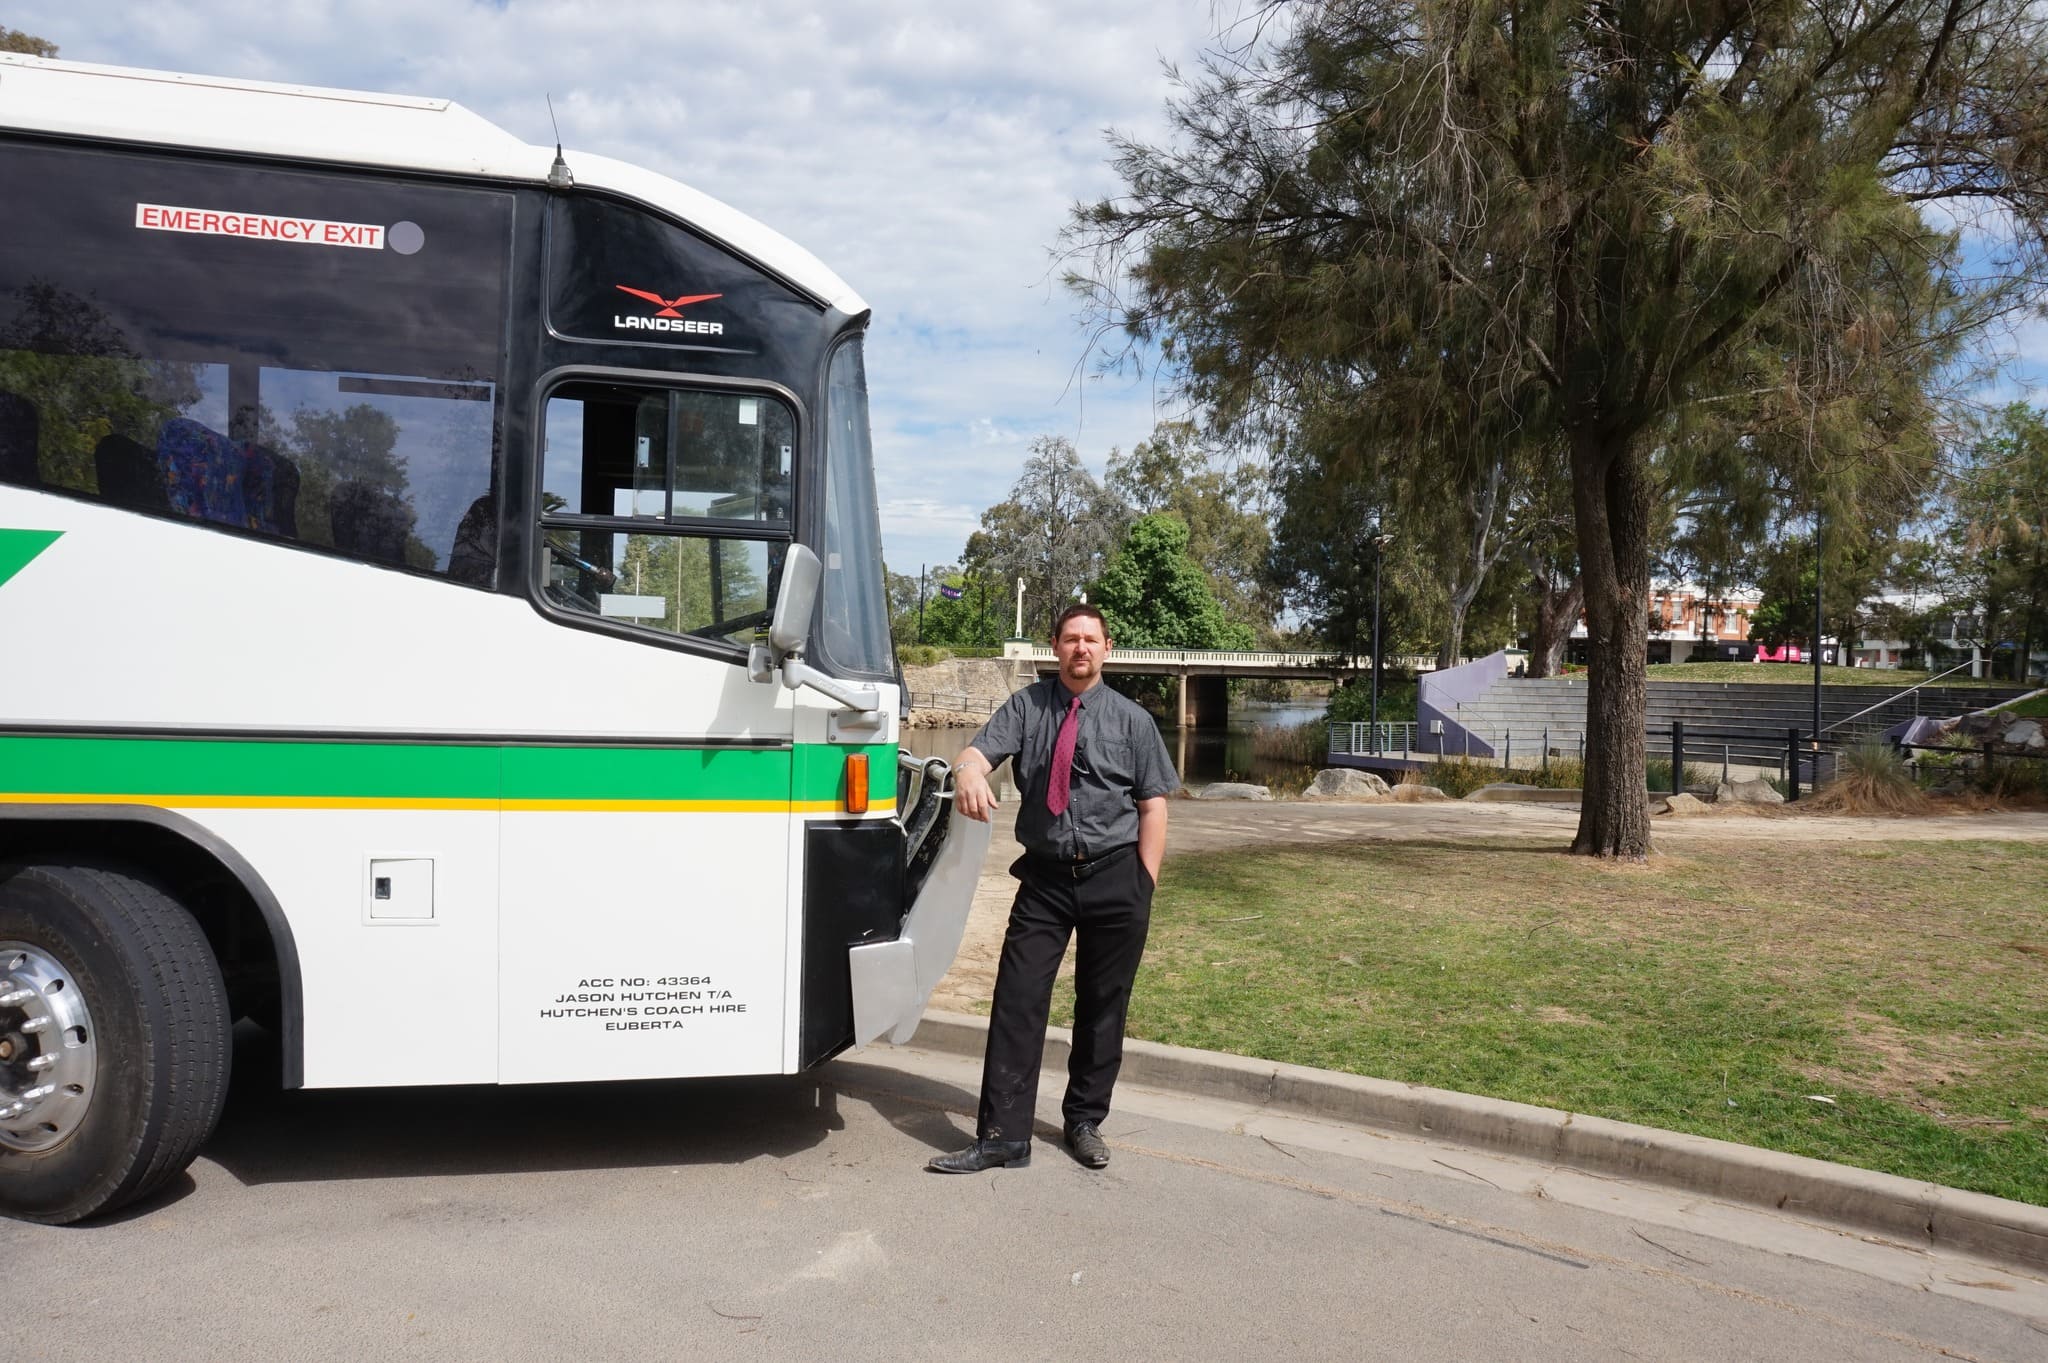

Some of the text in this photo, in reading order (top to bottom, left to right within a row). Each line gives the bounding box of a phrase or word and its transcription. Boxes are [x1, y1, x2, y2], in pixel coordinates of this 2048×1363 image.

[142, 207, 379, 246] EMERGENCY EXIT
[614, 315, 724, 336] LANDSEER
[578, 976, 711, 988] ACC NO: 43364
[555, 990, 732, 1003] JASON HUTCHEN T/A
[540, 1003, 747, 1018] HUTCHEN'S COACH HIRE
[605, 1021, 684, 1031] EUBERTA
